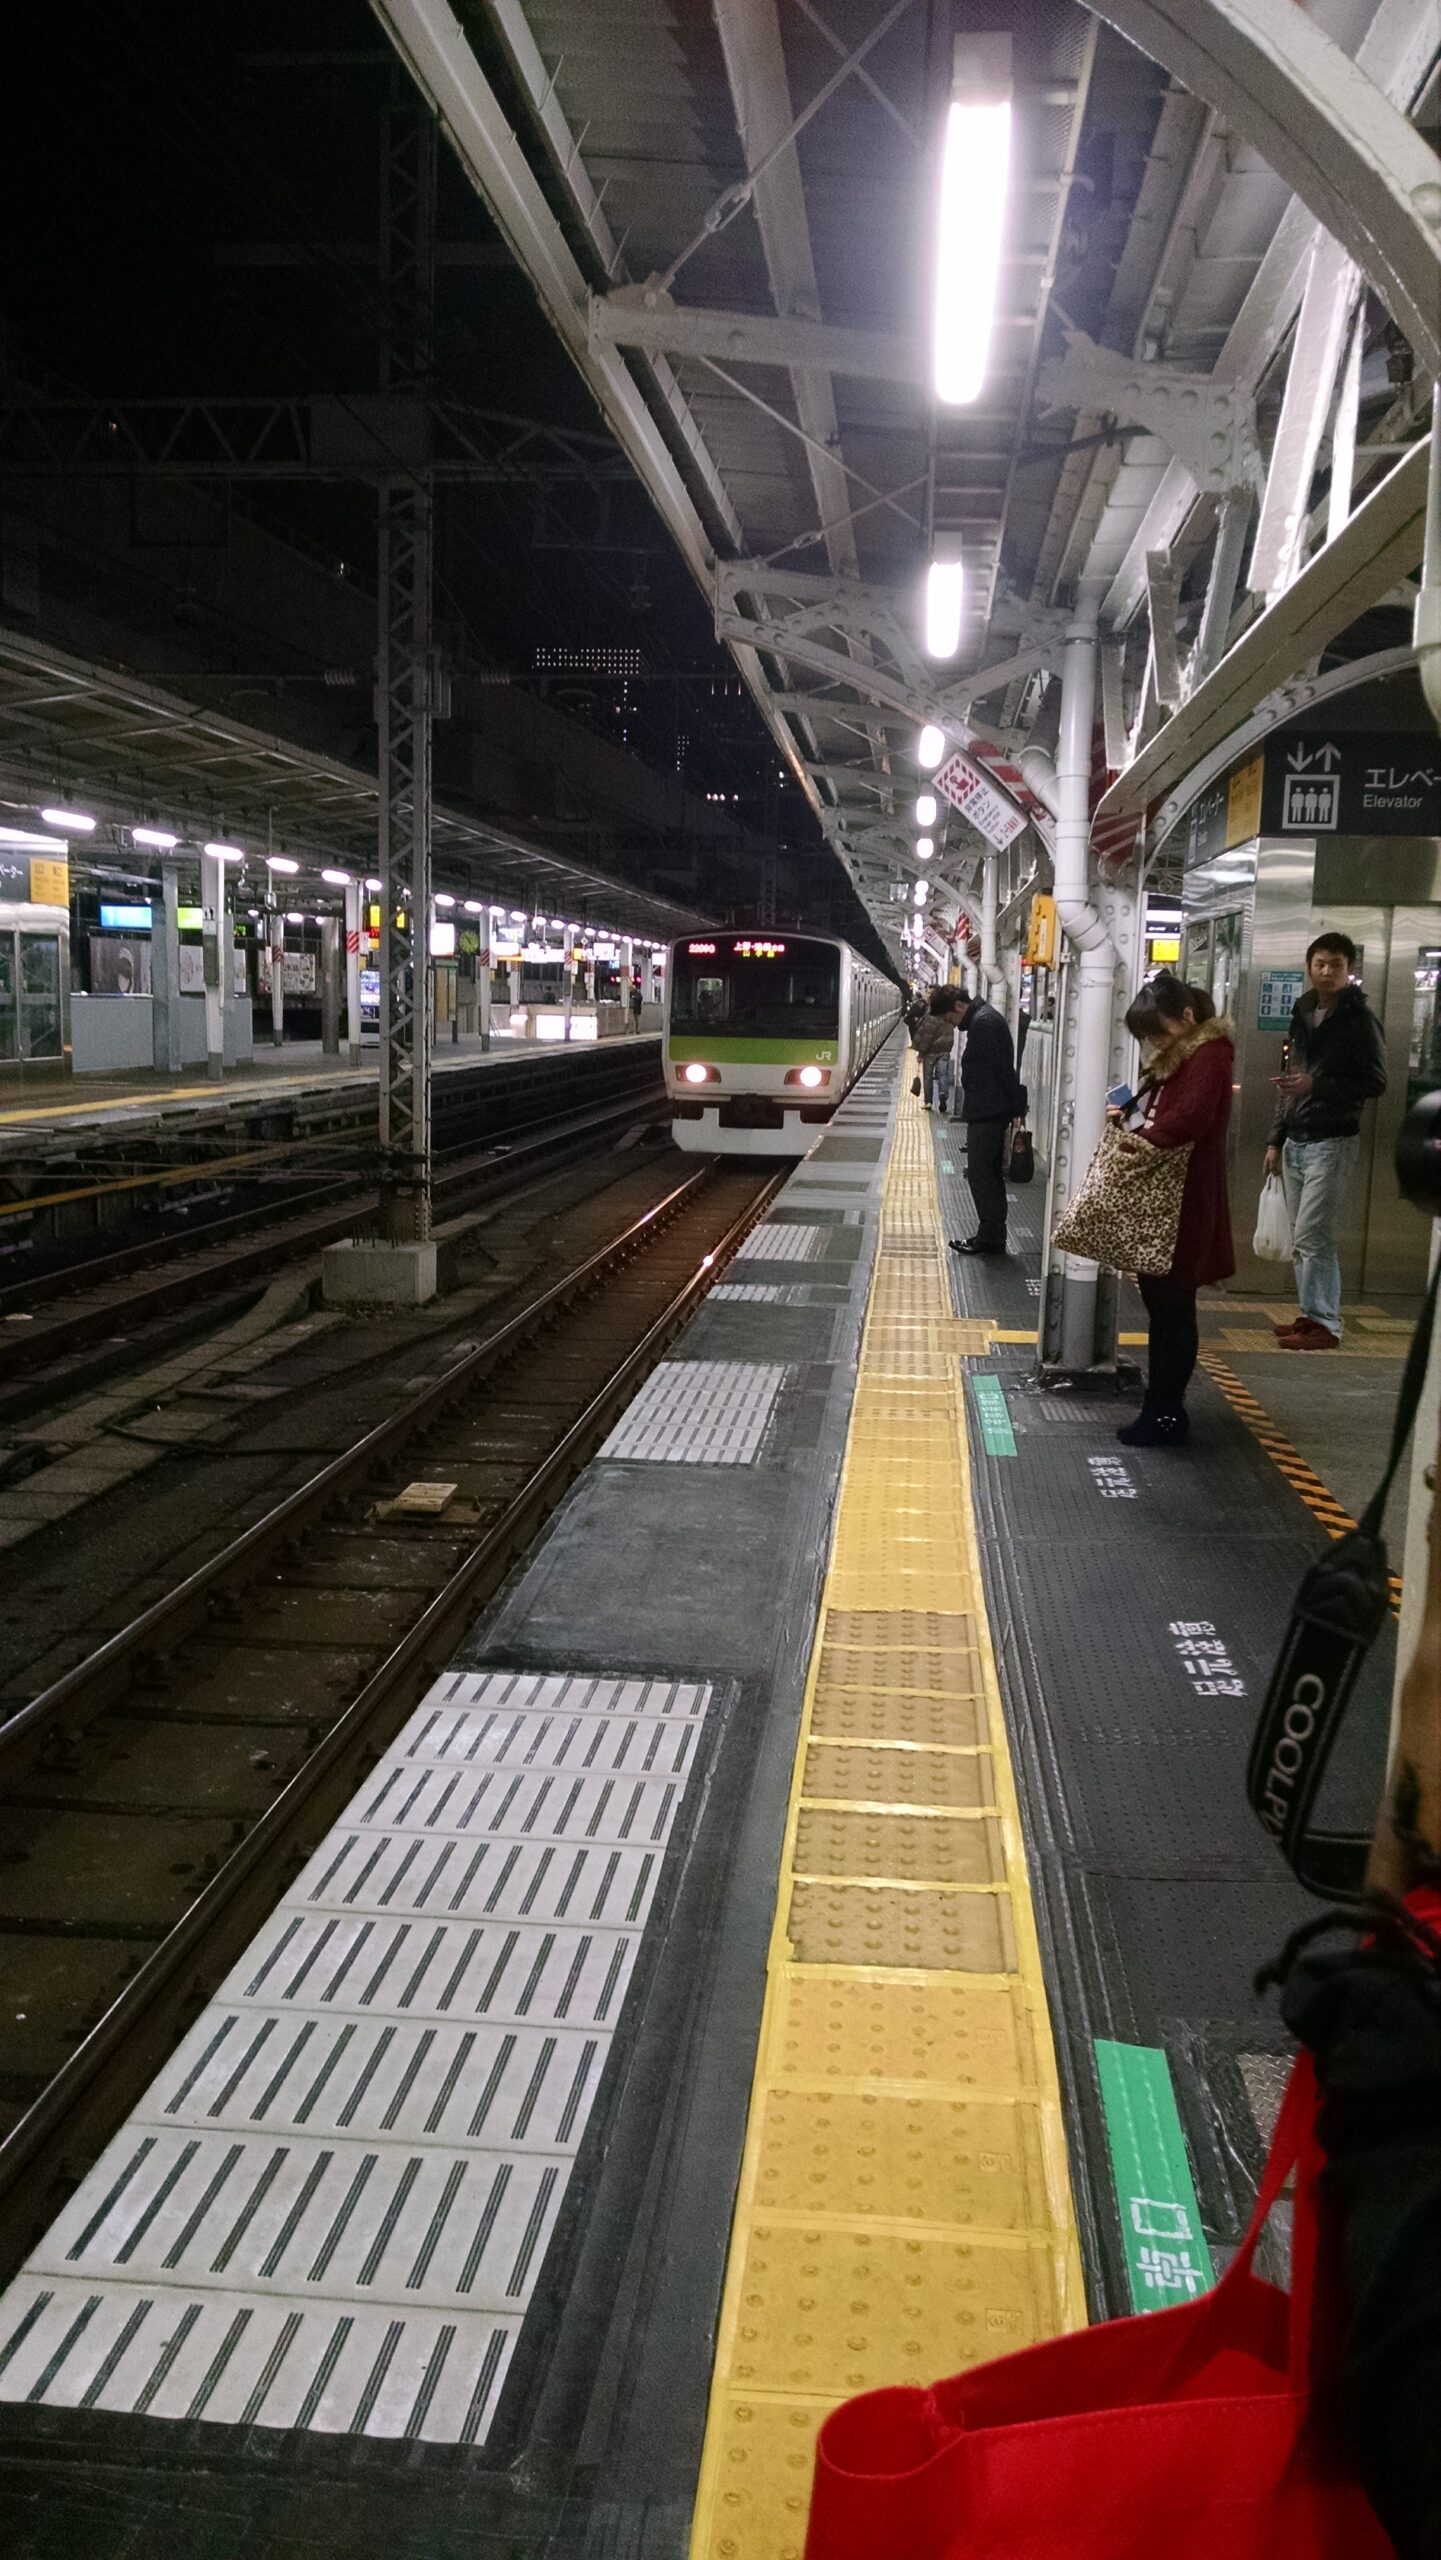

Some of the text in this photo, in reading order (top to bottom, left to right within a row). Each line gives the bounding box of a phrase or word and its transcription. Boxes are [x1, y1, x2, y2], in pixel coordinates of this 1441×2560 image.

[1364, 794, 1422, 807] Elevator
[815, 1051, 832, 1061] JR
[1087, 1455, 1139, 1499] 足元注意
[1168, 1620, 1248, 1698] 足元注意
